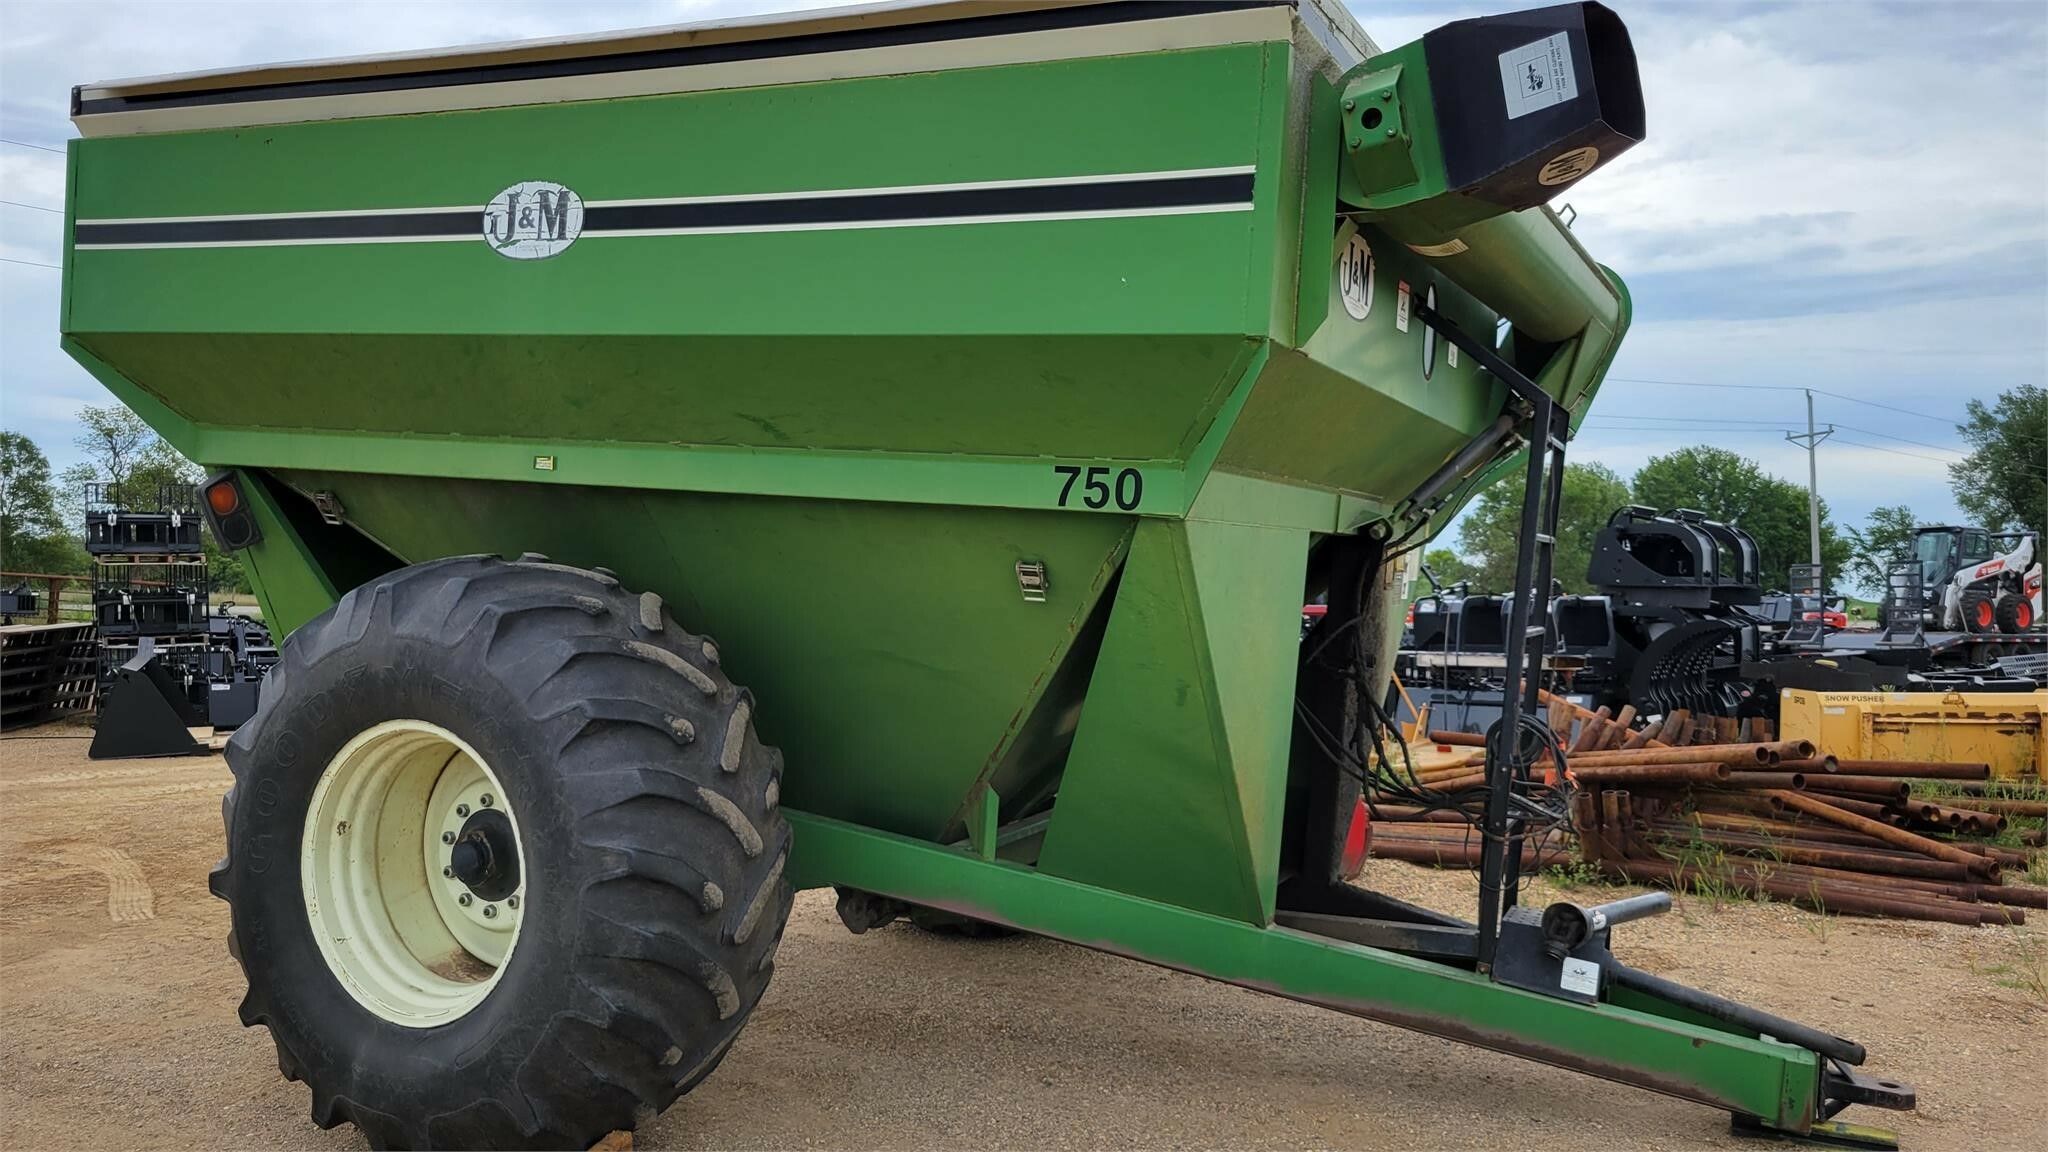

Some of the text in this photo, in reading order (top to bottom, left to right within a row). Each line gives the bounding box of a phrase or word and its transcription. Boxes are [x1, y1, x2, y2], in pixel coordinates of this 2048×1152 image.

[1546, 150, 1586, 182] J&M
[491, 191, 571, 243] J&M
[1343, 241, 1372, 308] J&M
[1055, 465, 1143, 511] 750
